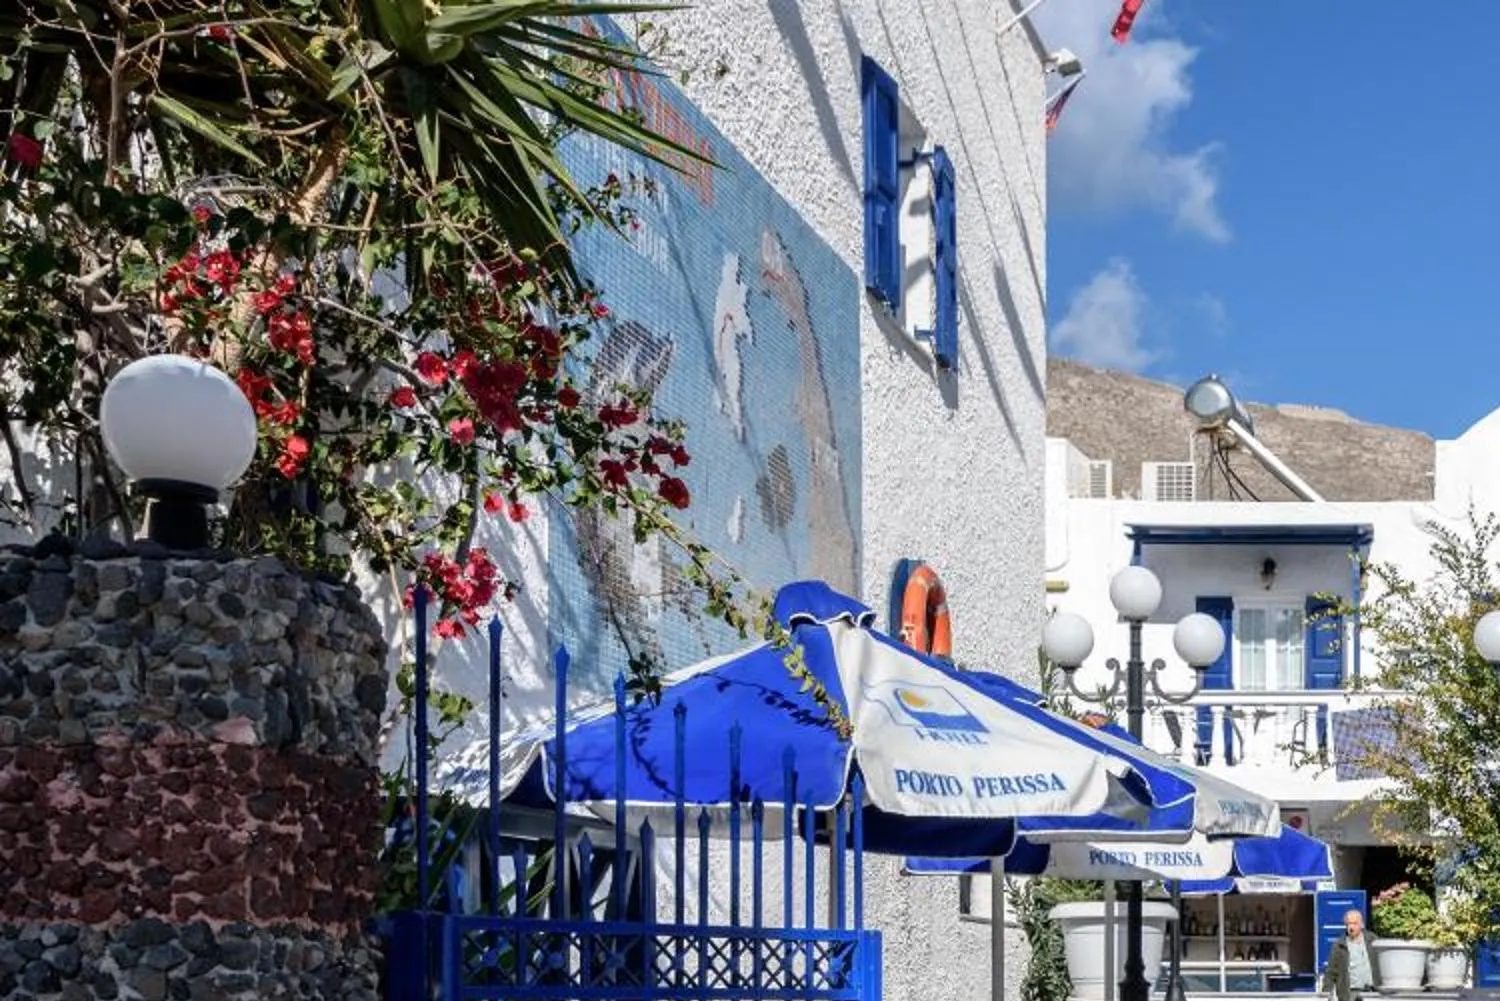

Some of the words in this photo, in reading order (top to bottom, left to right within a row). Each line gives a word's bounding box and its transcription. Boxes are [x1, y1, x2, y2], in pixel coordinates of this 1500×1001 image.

[894, 768, 964, 798] PORTO
[971, 772, 1067, 799] PERISSA
[1088, 849, 1137, 867] PORTO
[1144, 850, 1203, 867] PERISSA
